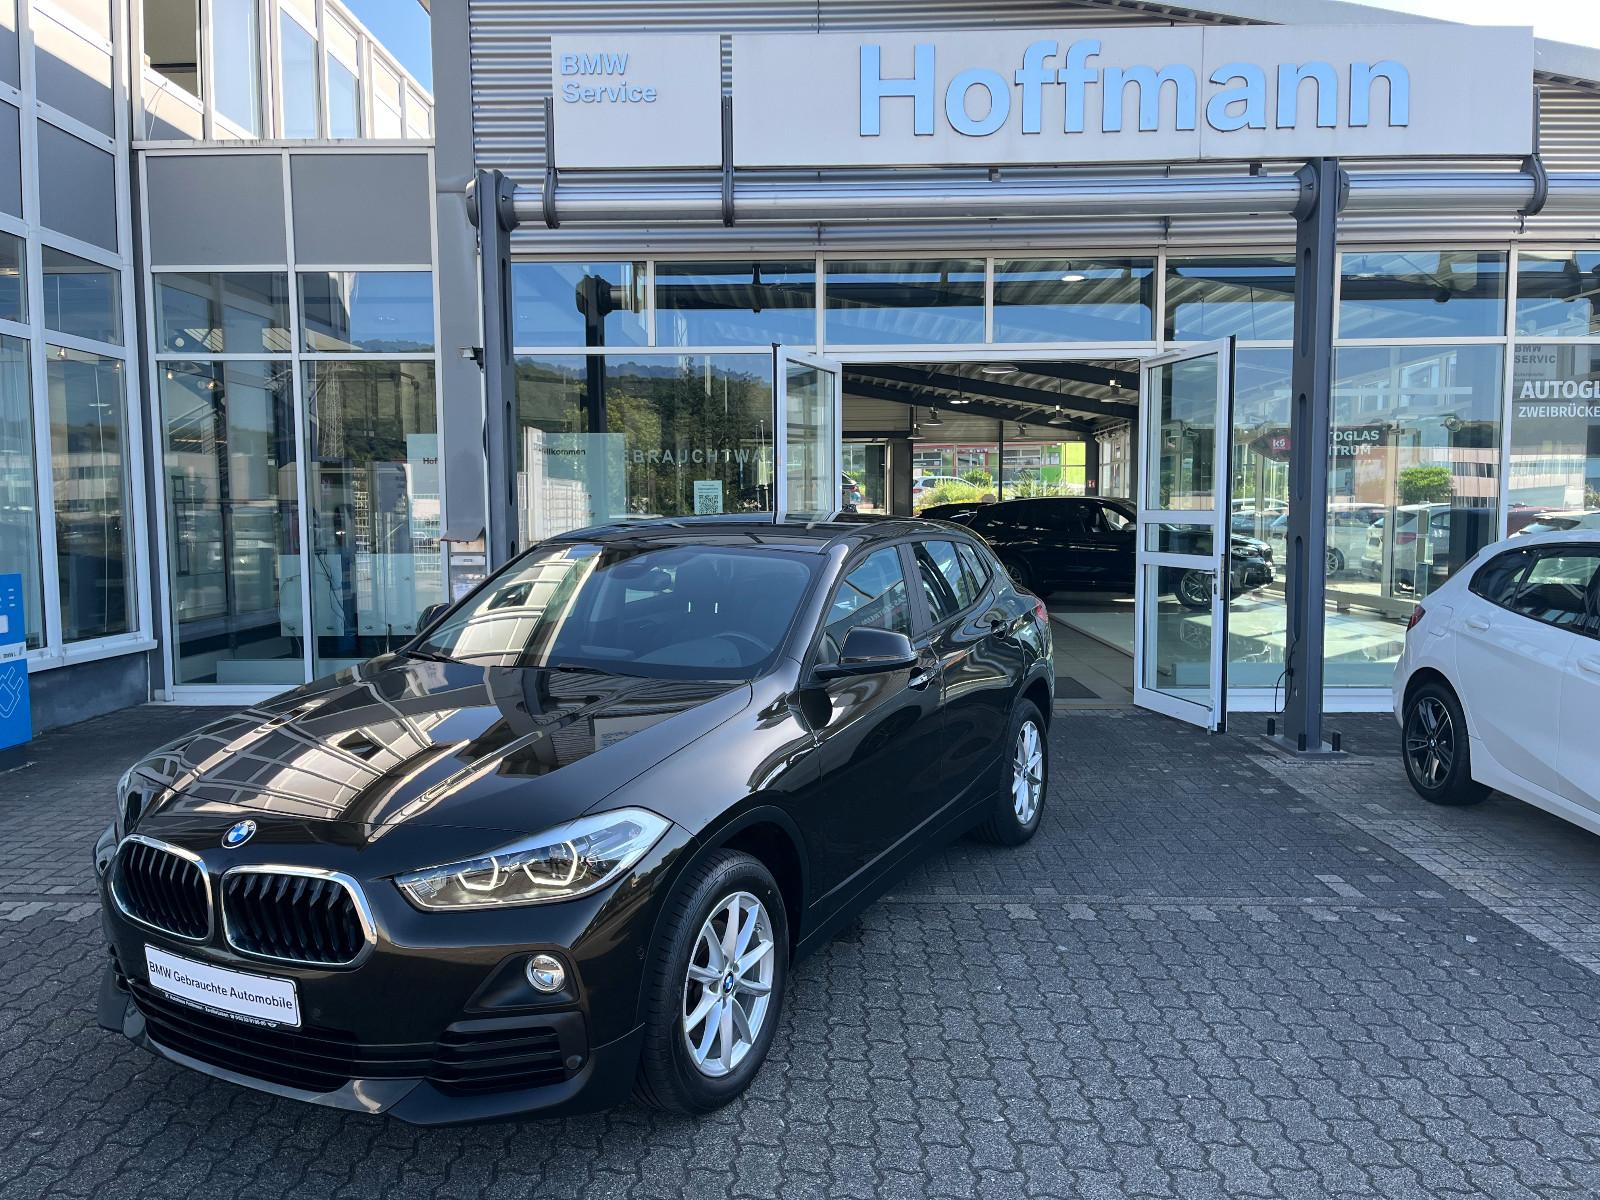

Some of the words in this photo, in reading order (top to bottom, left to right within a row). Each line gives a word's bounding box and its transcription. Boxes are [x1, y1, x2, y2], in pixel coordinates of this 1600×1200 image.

[560, 52, 630, 76] BMW
[562, 80, 658, 104] Service
[859, 39, 1411, 137] Hoffmann
[1329, 430, 1380, 441] OGLAS
[149, 960, 171, 980] BMW
[173, 971, 228, 996] Gebrauchte
[229, 986, 293, 1010] Automobile
